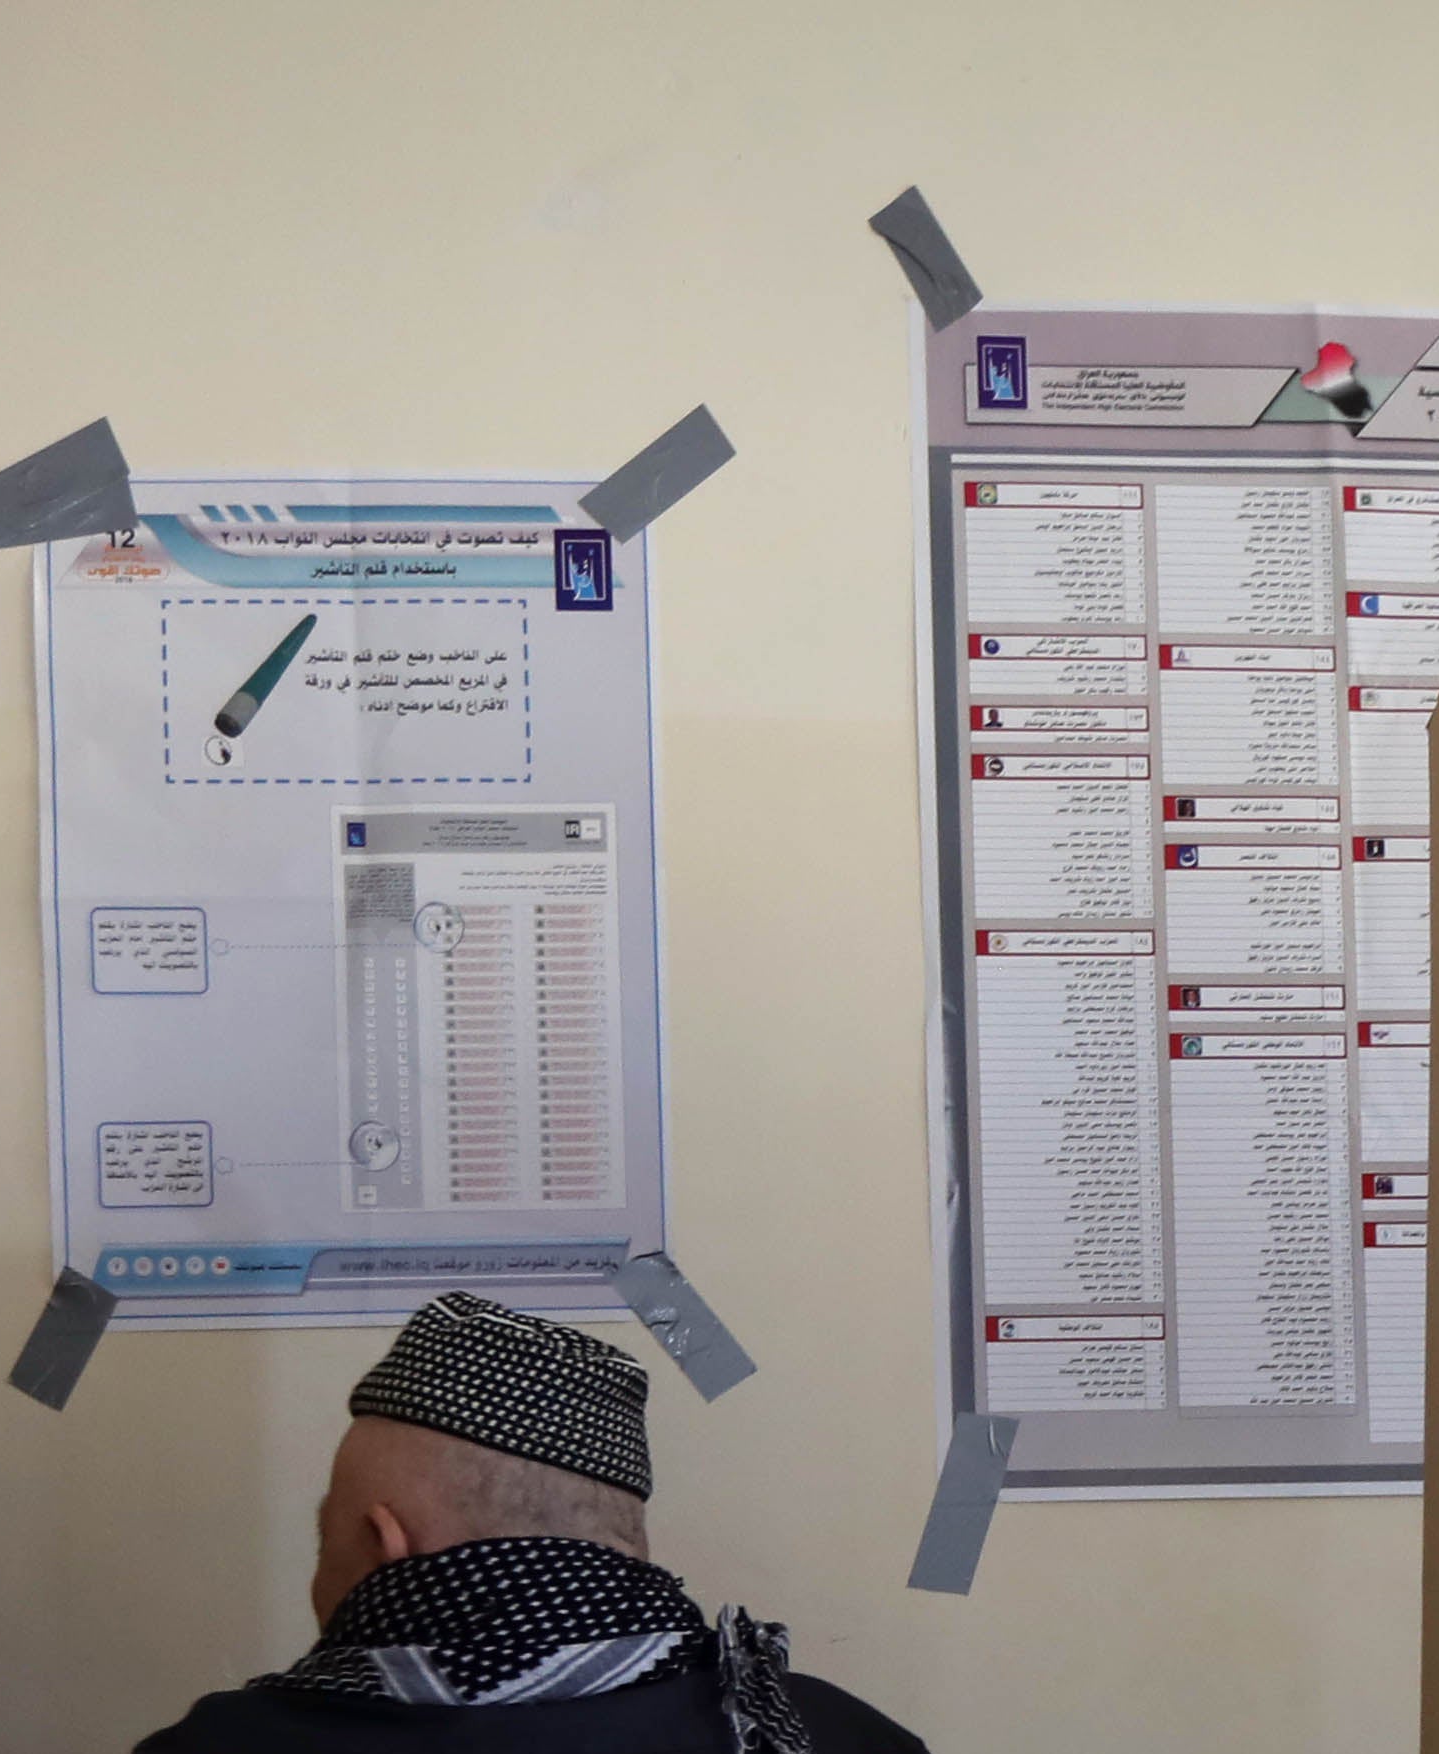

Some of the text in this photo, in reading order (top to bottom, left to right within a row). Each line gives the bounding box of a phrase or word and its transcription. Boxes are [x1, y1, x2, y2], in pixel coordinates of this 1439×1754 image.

[107, 528, 135, 548] 12
[219, 530, 539, 553] كيف تصوت في انتخابات مجلس النواب ٢٠١٨
[364, 560, 388, 577] قلم
[392, 561, 457, 575] باستخدام
[354, 649, 372, 665] قلم
[379, 649, 400, 665] ختم
[407, 649, 433, 665] وضع
[440, 649, 479, 665] الناخب
[485, 649, 507, 665] على
[305, 674, 331, 690] ورقة
[337, 674, 350, 690] في
[404, 674, 453, 690] المخصص
[459, 674, 488, 690] المربع
[494, 674, 507, 690] في
[397, 699, 433, 715] موضح
[438, 699, 461, 715] وكما
[467, 699, 508, 715] الاقتراع
